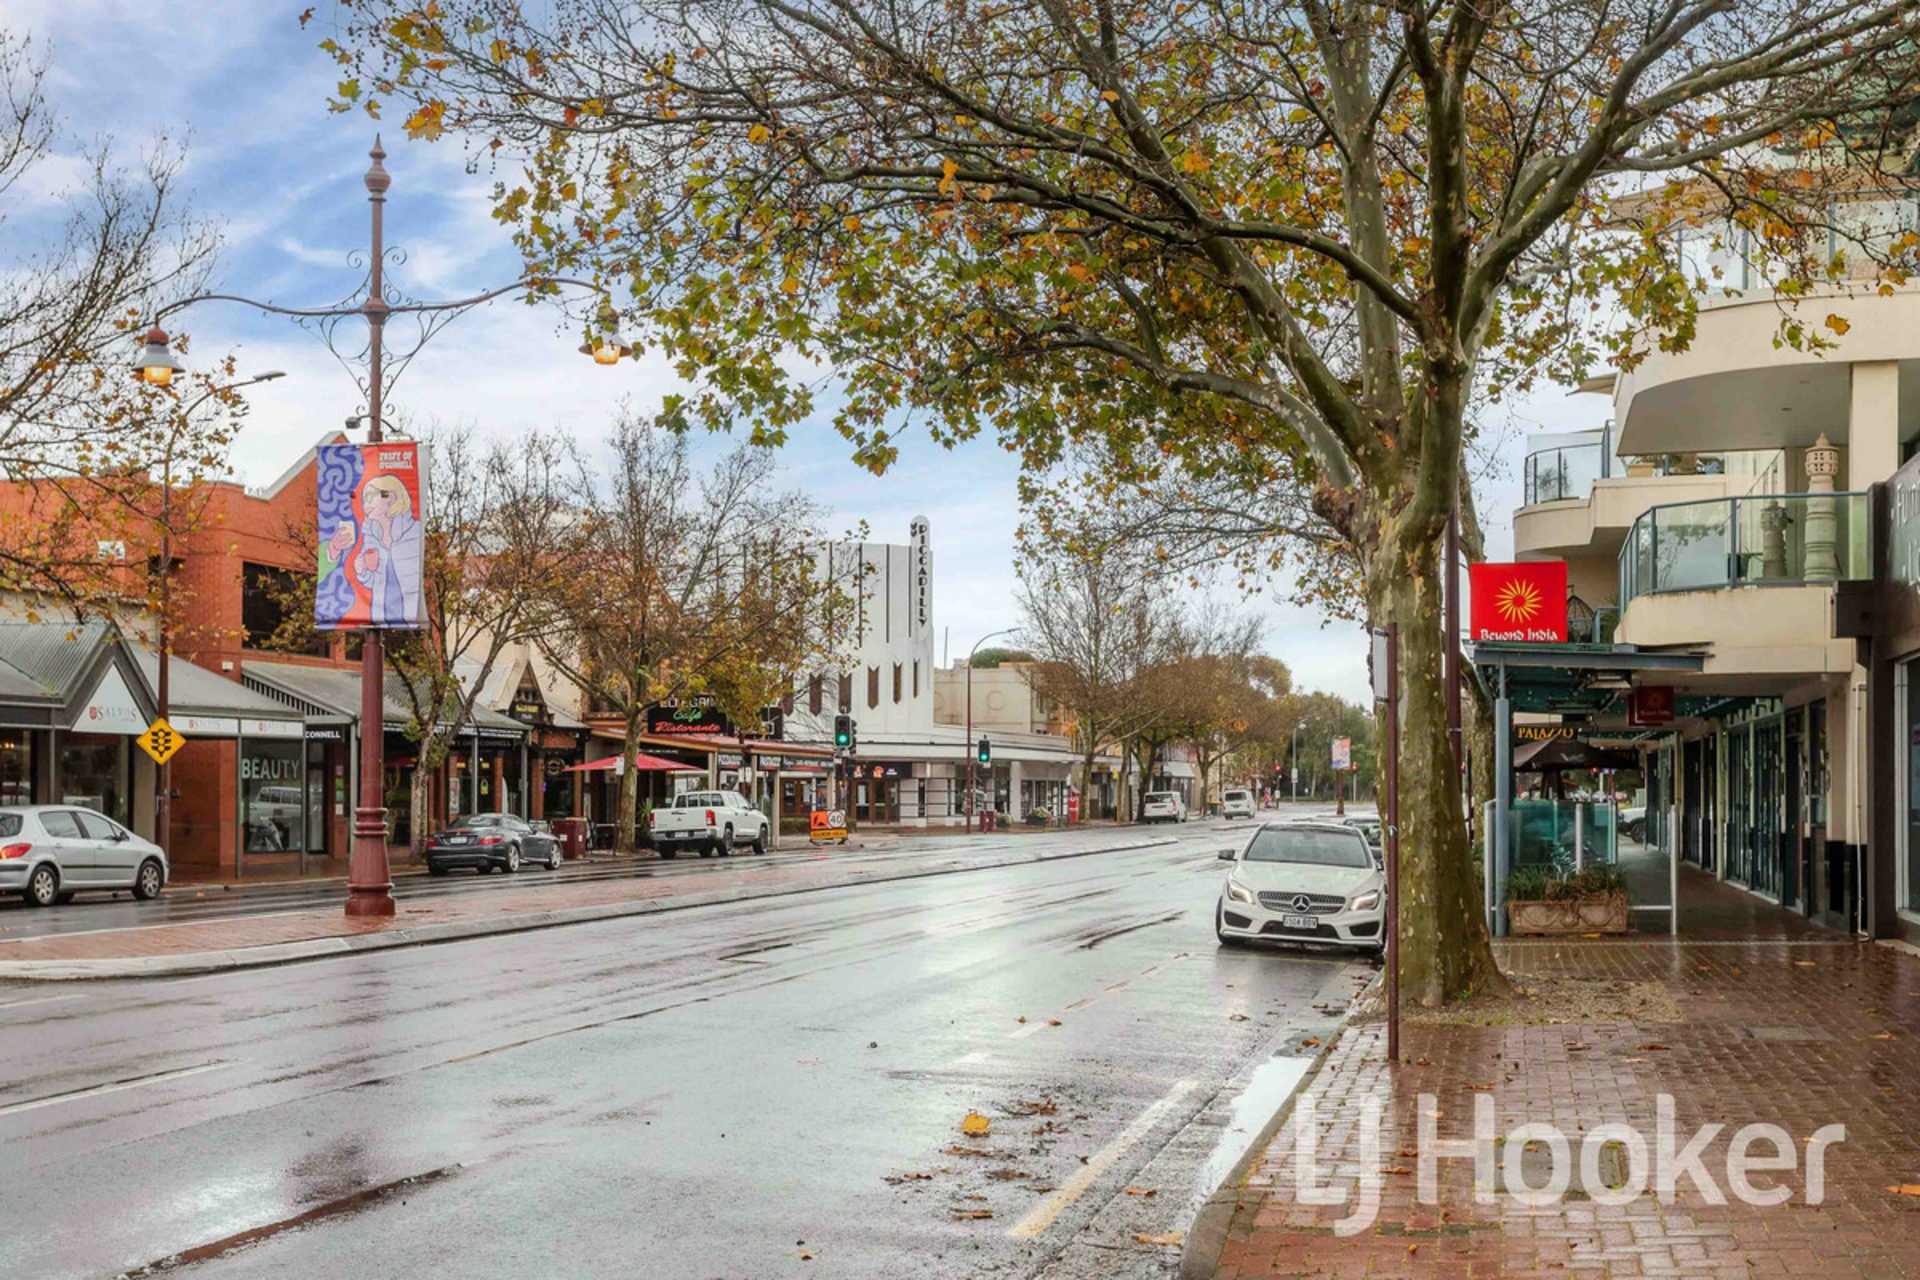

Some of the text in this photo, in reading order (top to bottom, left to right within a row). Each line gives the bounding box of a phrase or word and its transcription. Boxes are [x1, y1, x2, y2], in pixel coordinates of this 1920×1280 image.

[918, 524, 928, 628] PICCADILLY
[1480, 628, 1558, 641] Beyond India
[655, 721, 721, 732] Ristorante
[242, 757, 300, 779] BEAUTY
[830, 814, 842, 824] 40
